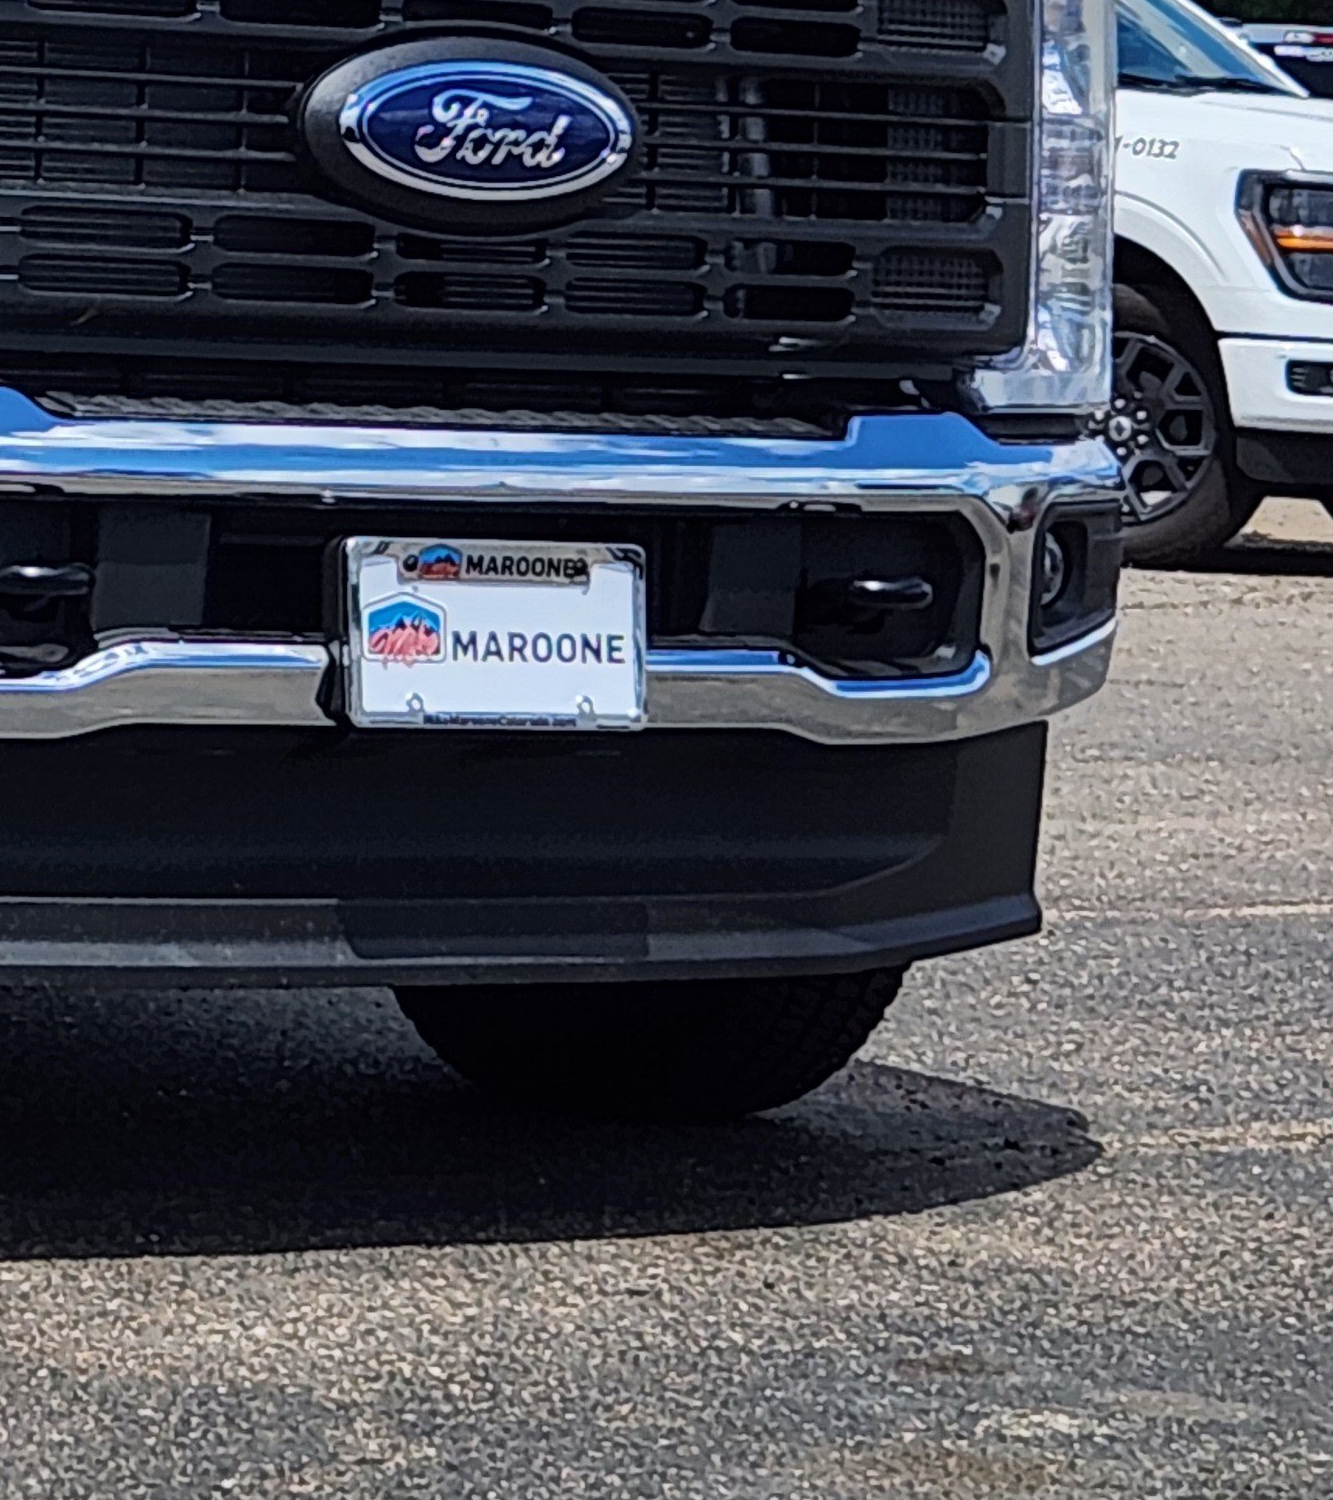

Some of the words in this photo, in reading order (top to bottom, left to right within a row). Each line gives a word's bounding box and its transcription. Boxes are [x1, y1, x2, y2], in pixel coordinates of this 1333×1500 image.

[414, 89, 572, 168] Ford
[465, 554, 580, 578] MAROONE
[452, 630, 626, 664] MAROONE
